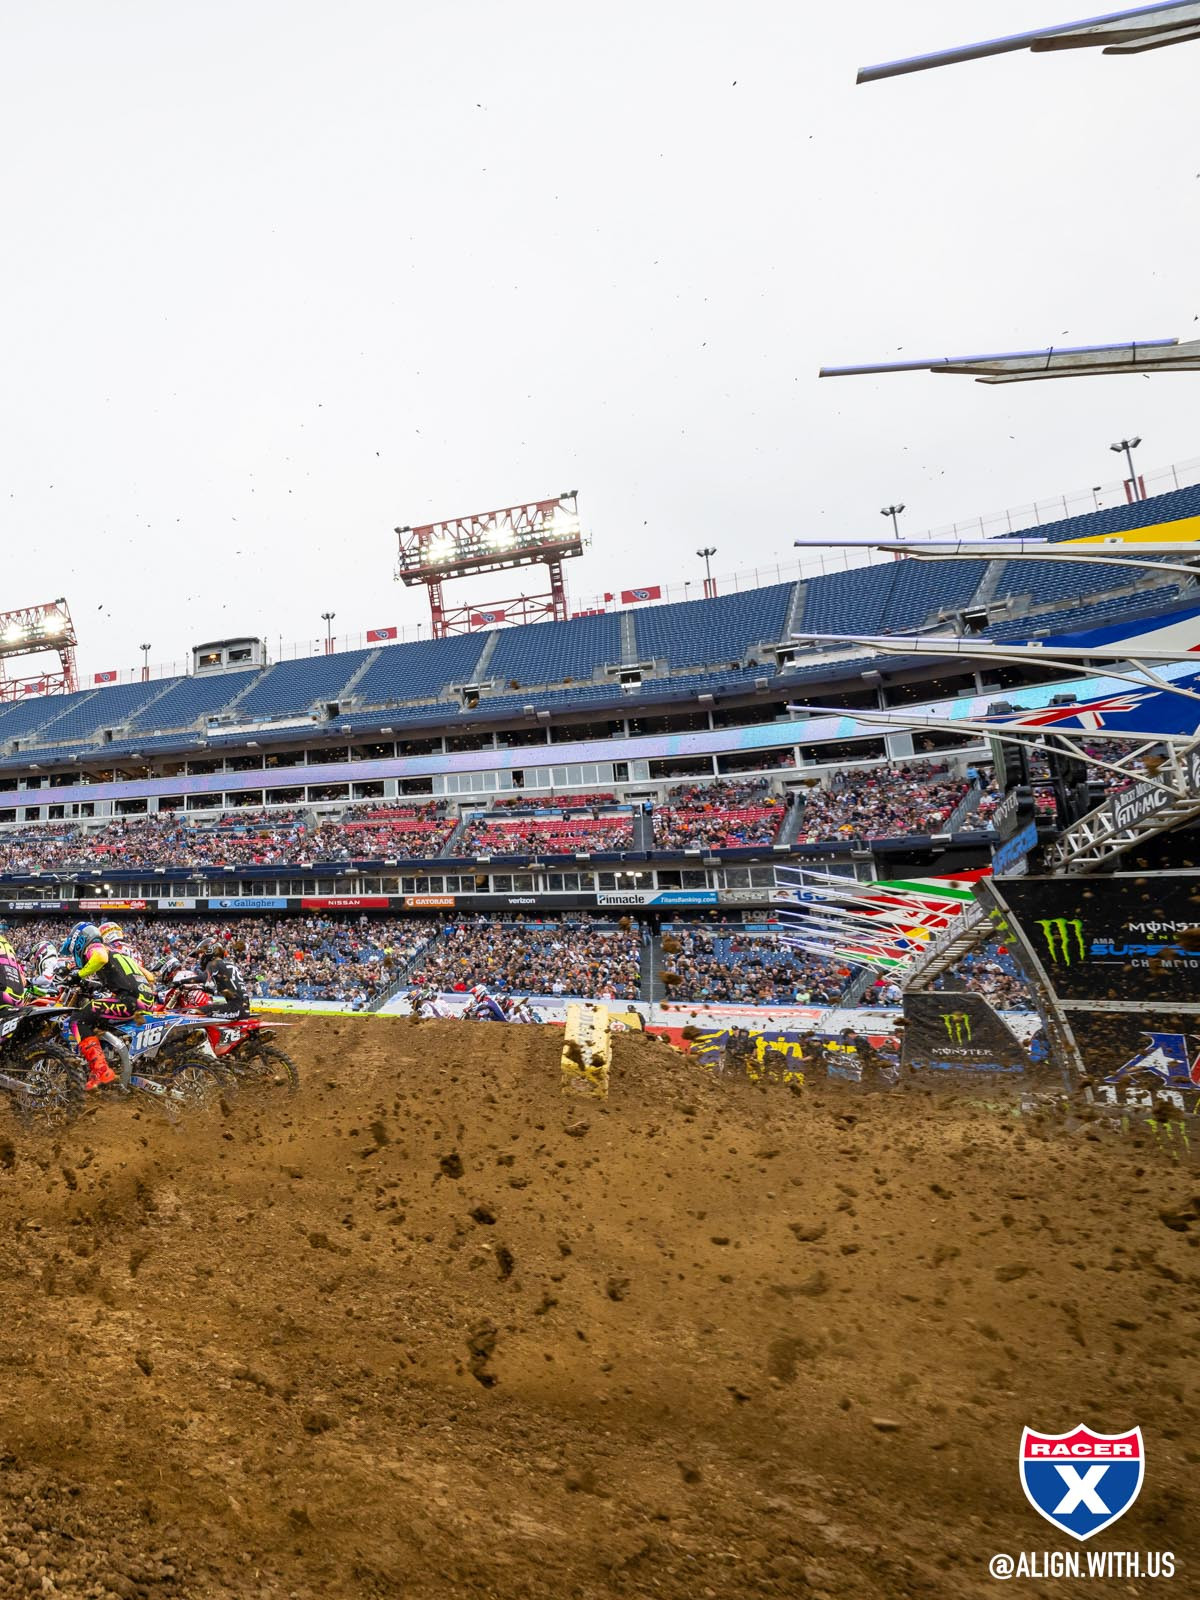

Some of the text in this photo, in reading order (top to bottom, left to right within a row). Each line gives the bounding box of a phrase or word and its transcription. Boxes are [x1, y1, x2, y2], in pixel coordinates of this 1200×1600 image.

[234, 899, 276, 909] Gallagher
[598, 894, 645, 904] Pinnacle
[92, 1001, 131, 1016] FXR
[1, 1019, 19, 1036] 26
[136, 1026, 163, 1050] 116
